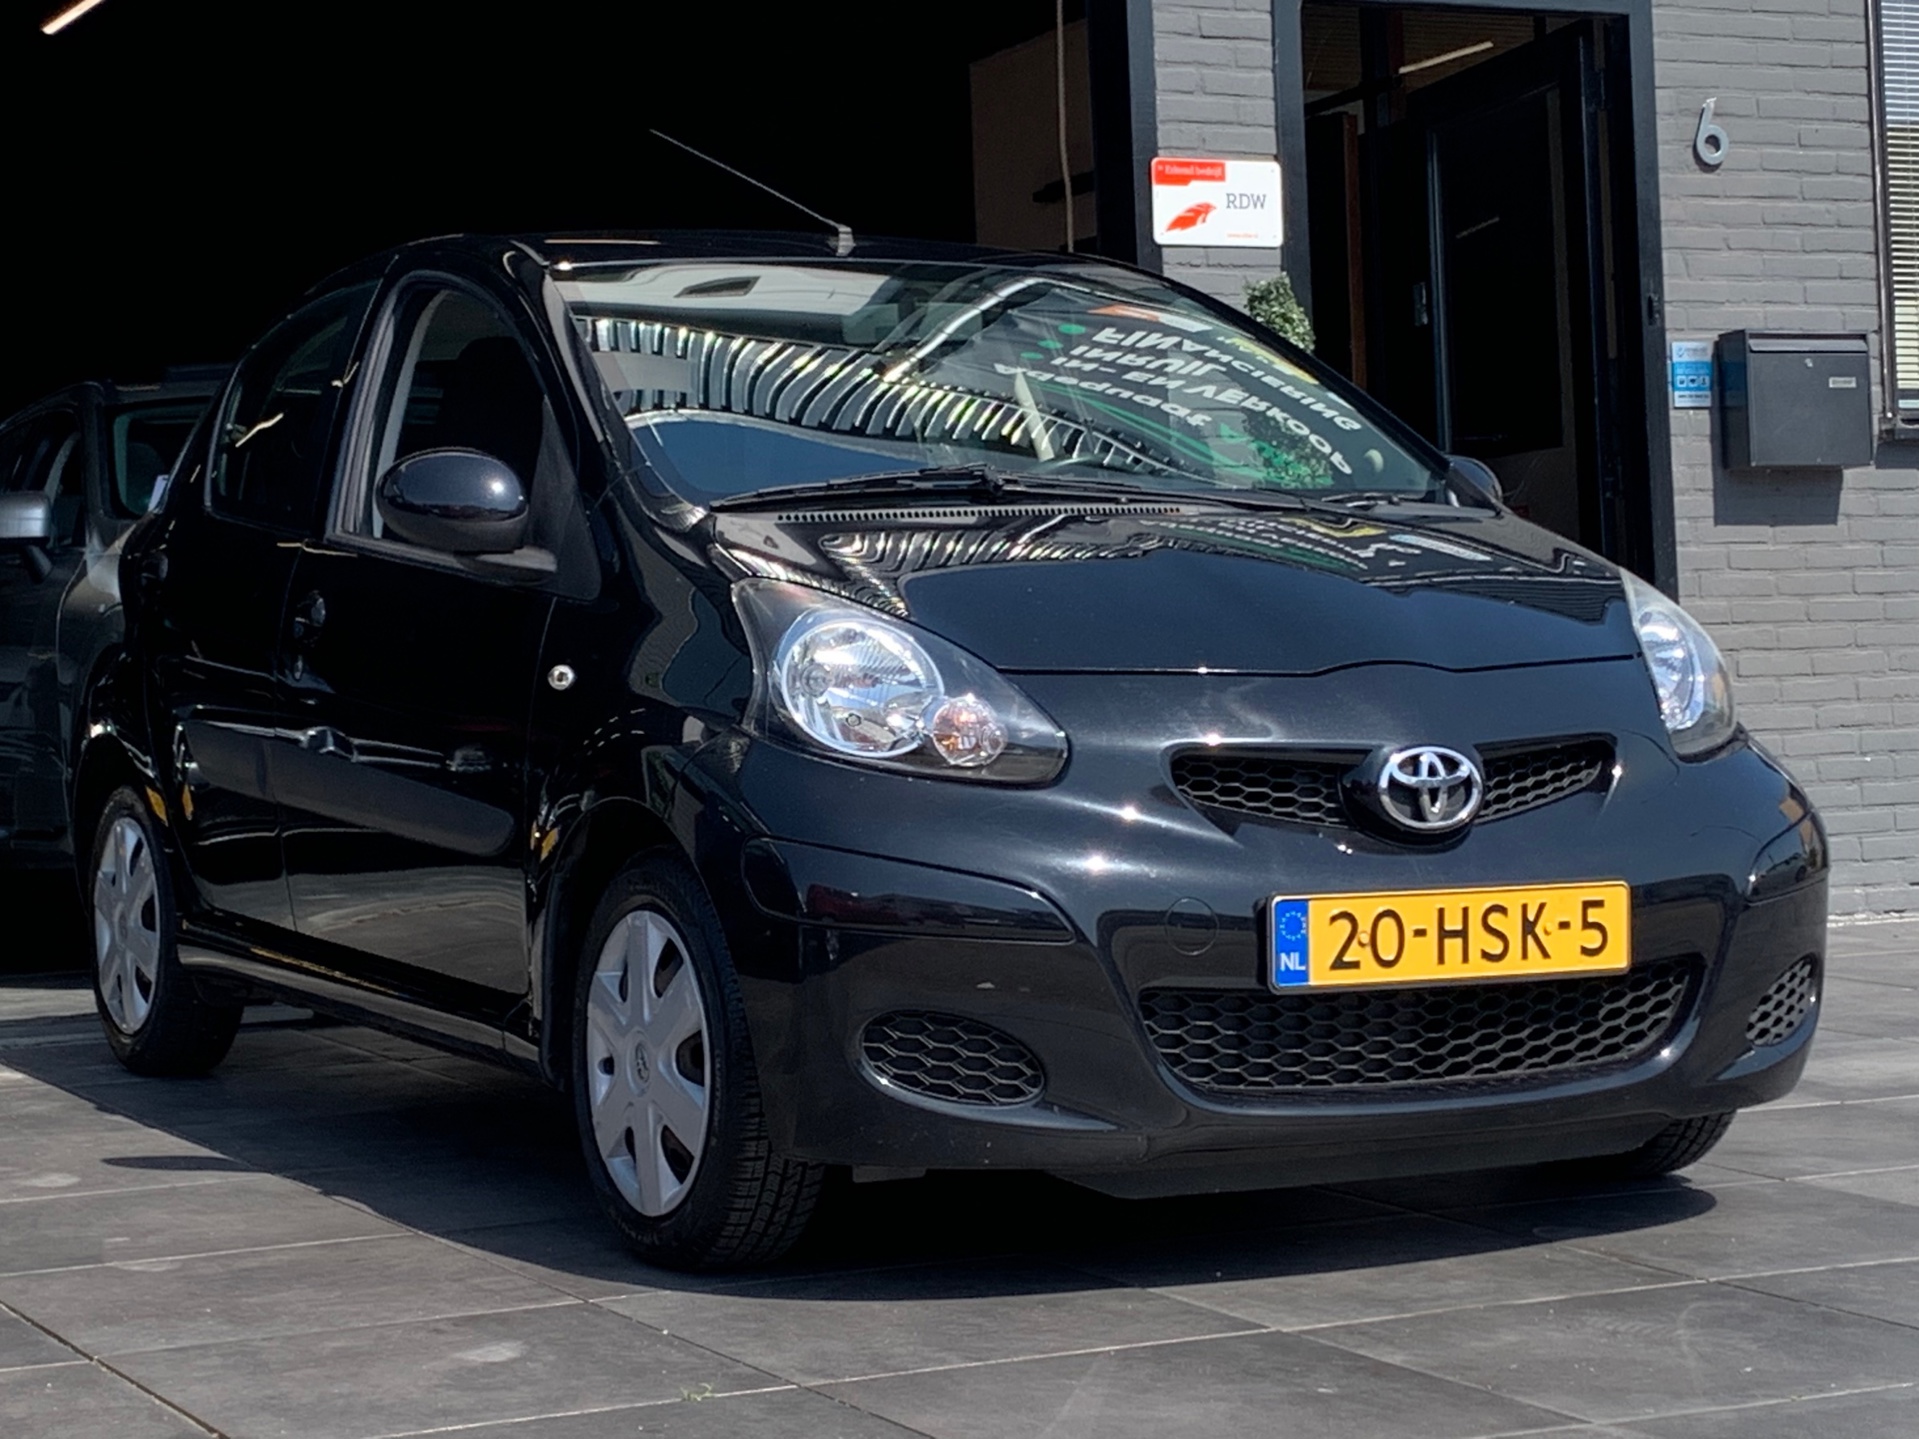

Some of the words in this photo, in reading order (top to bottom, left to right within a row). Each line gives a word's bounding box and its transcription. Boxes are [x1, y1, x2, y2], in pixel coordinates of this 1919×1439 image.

[1696, 97, 1729, 165] 6
[1226, 193, 1267, 210] RDW
[1328, 899, 1609, 972] 20-HSK-5
[1280, 952, 1306, 972] NL
